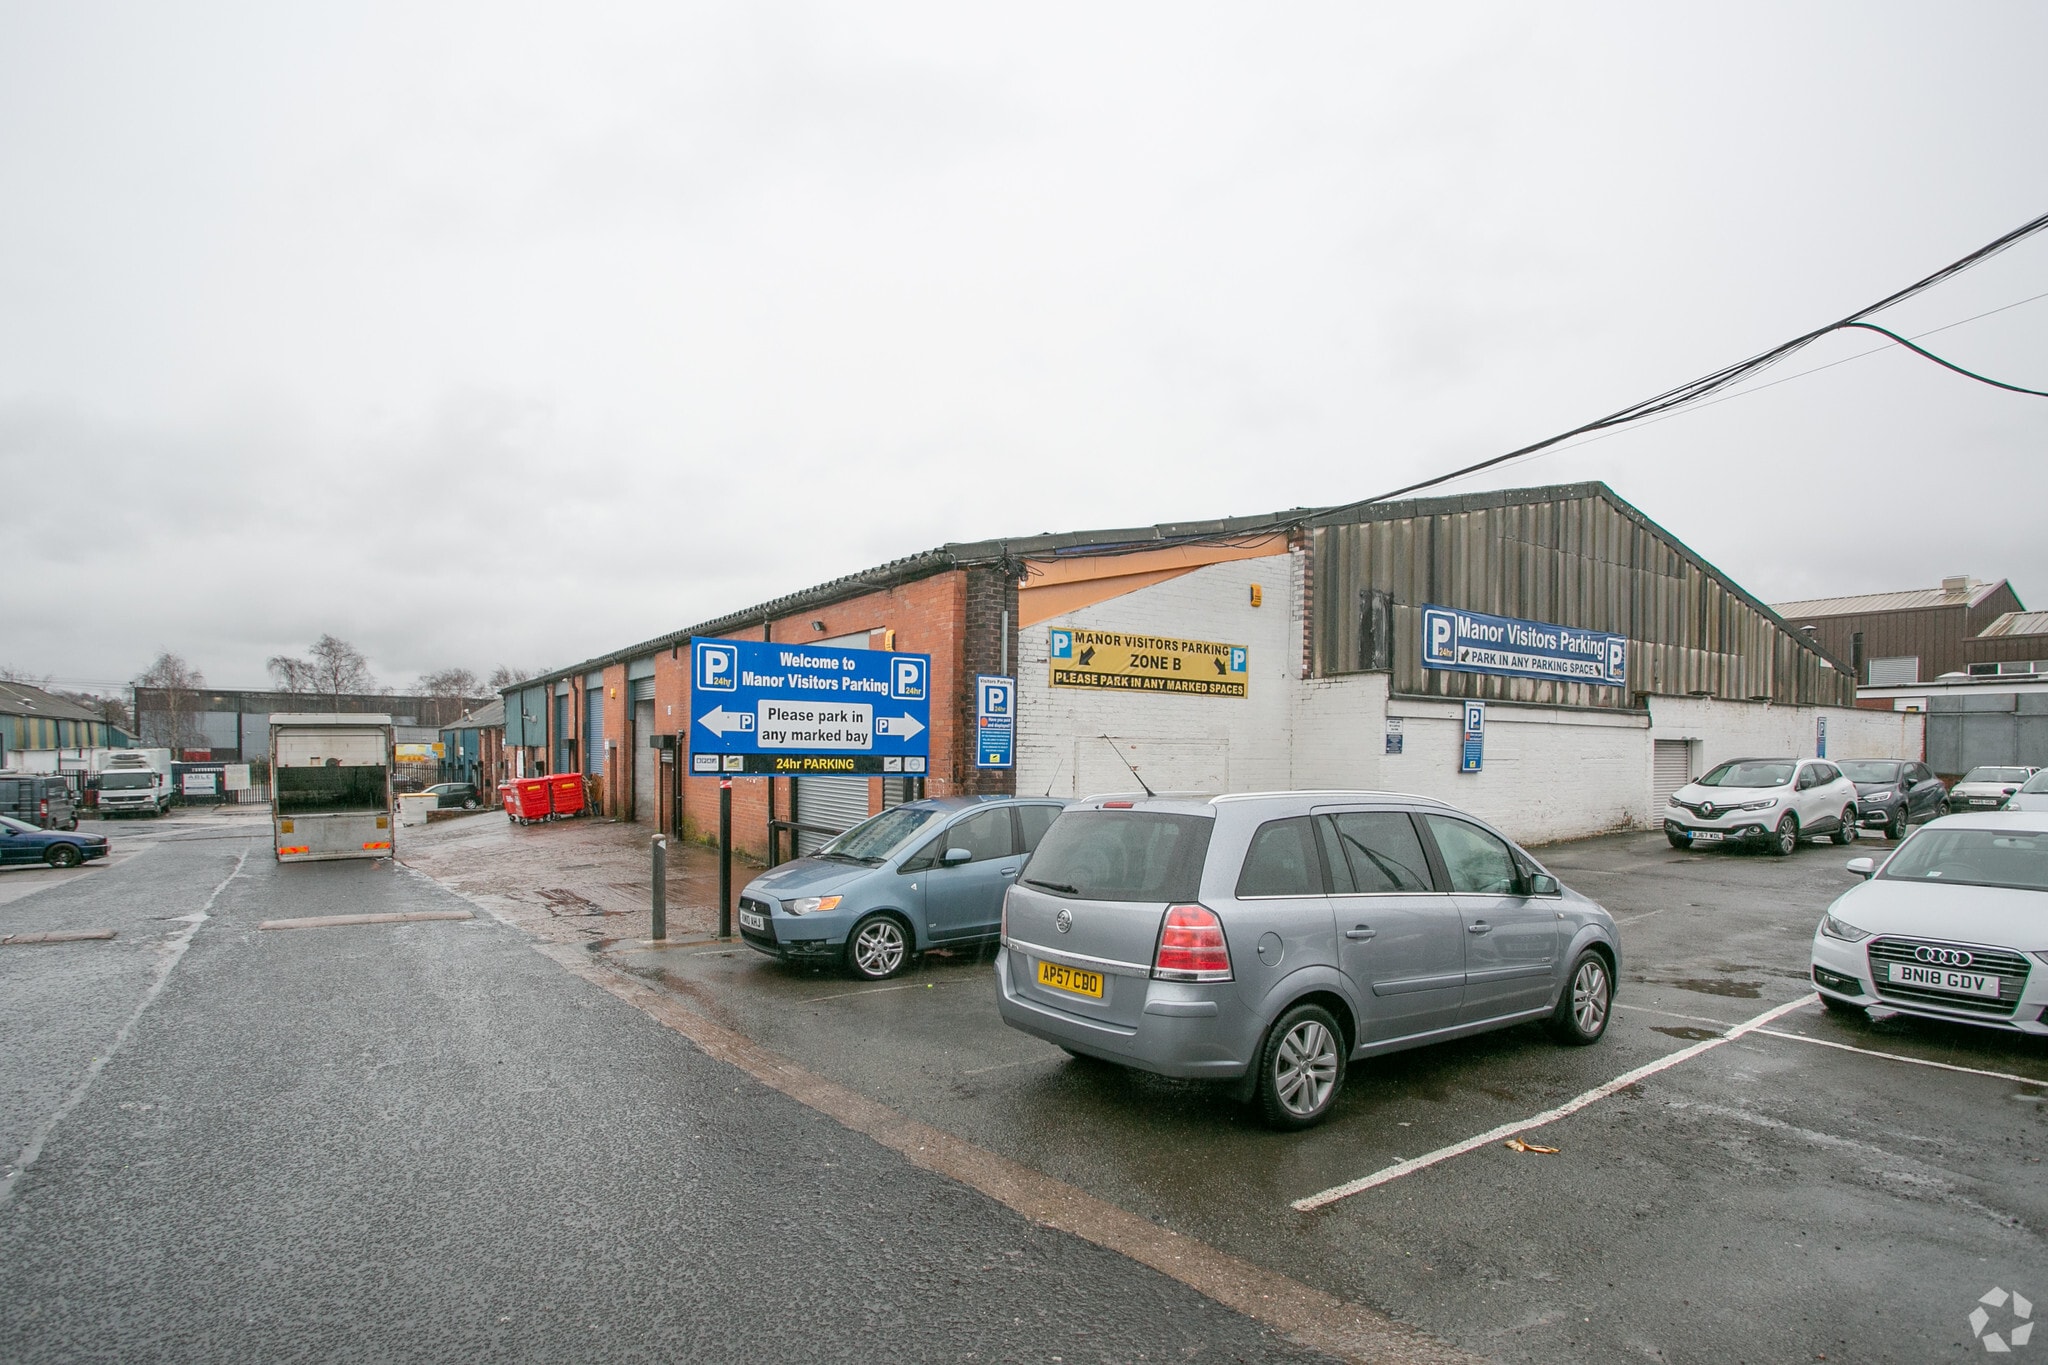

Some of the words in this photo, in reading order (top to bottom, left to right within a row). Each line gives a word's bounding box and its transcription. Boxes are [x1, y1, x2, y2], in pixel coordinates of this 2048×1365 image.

[1075, 632, 1121, 646] MANOR
[1125, 636, 1178, 651] VISITORS
[1182, 642, 1229, 656] PARKING
[1458, 616, 1504, 642] Manor
[1507, 623, 1557, 650] Visitors
[1561, 631, 1605, 660] Parking
[706, 650, 728, 685] P
[780, 652, 839, 669] Welcome
[842, 657, 855, 670] to
[1130, 654, 1168, 670] ZONE
[1173, 658, 1181, 670] B
[1472, 651, 1496, 664] PARK
[1499, 655, 1508, 665] IN
[1511, 657, 1529, 668] ANY
[1532, 658, 1568, 672] PARKING
[1570, 663, 1593, 675] SPACE
[713, 677, 731, 687] 24hr
[742, 671, 784, 687] Manor
[787, 674, 838, 690] Visitors
[842, 677, 888, 695] Parking
[898, 663, 918, 694] P
[1056, 672, 1098, 685] PLEASE
[1101, 675, 1129, 687] PARK
[1131, 677, 1141, 687] IN
[1143, 679, 1165, 689] ANY
[1167, 680, 1207, 692] MARKED
[1209, 683, 1243, 695] SPACES
[768, 707, 814, 721] Please
[818, 710, 848, 724] park
[852, 711, 863, 723] in
[762, 730, 787, 743] any
[791, 729, 841, 742] marked
[846, 730, 868, 745] bay
[776, 758, 801, 769] 24hr
[804, 758, 854, 770] PARKING
[1043, 964, 1070, 986] AP57
[1901, 967, 1941, 984] BN18
[1947, 973, 1985, 990] GDV
